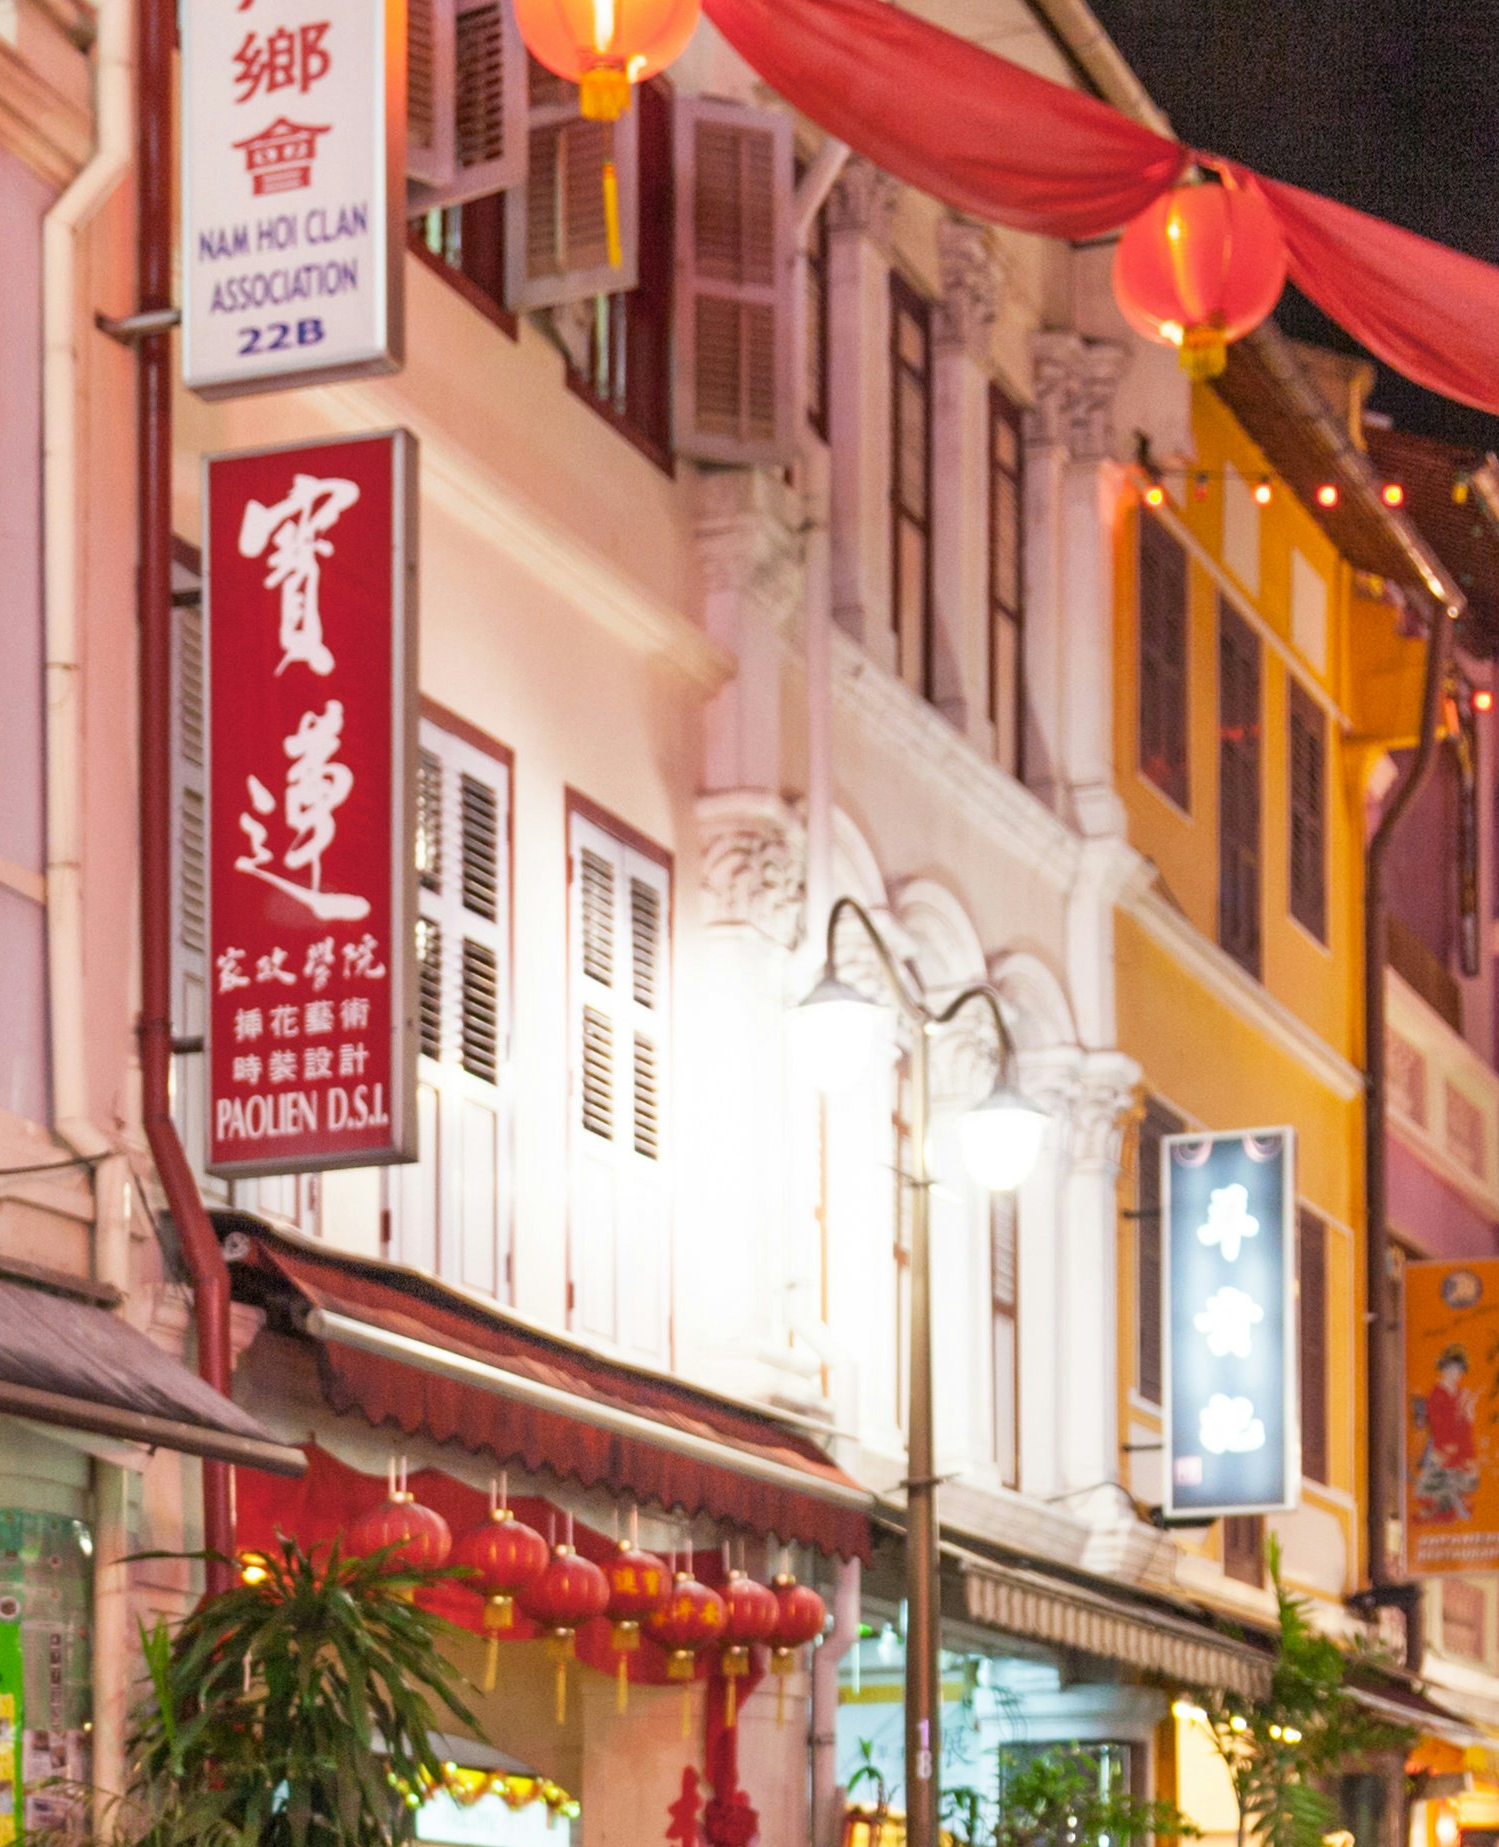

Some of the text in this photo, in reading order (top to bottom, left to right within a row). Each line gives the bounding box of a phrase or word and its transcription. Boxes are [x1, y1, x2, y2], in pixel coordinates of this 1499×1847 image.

[232, 0, 332, 197] 鄉會
[199, 203, 368, 262] NAM HOI CLAN
[210, 258, 358, 315] ASSOCIATION
[237, 317, 326, 357] 22B
